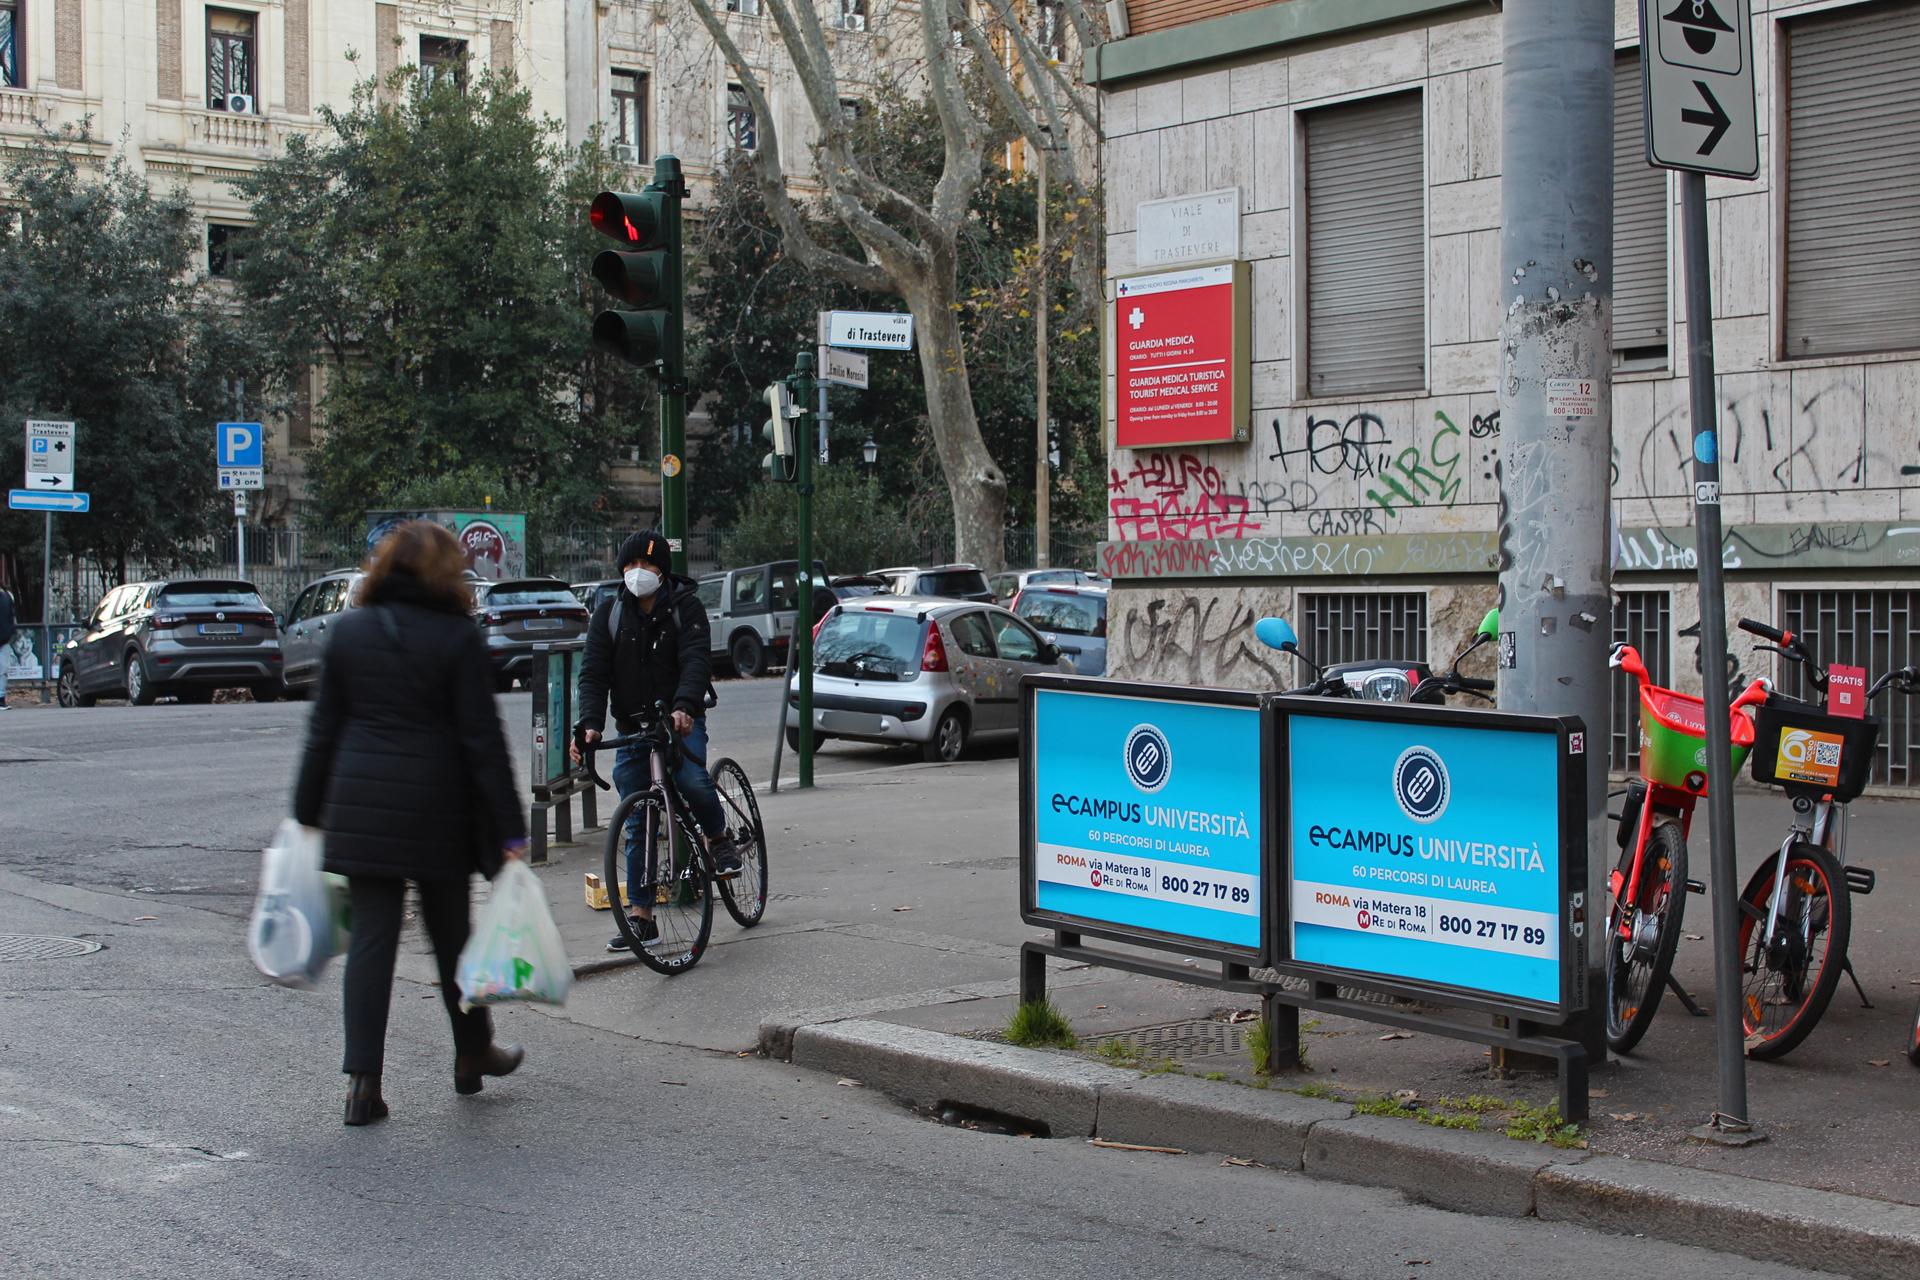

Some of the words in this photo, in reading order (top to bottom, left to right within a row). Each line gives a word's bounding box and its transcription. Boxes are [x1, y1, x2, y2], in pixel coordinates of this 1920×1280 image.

[1171, 204, 1202, 218] VIALE
[1182, 225, 1191, 237] DI
[847, 328, 856, 340] di
[859, 328, 906, 342] Trastevere
[1130, 338, 1164, 350] GUARDIA
[1165, 335, 1194, 346] MEDICA
[1130, 376, 1161, 388] GUARDIA
[1162, 374, 1188, 384] MEDICA
[1189, 370, 1225, 382] TURISTICA
[1129, 388, 1159, 399] TOURIST
[1160, 385, 1189, 397] MEDICAL
[1191, 383, 1218, 394] SERVICE
[1579, 383, 1591, 395] 12
[235, 478, 240, 486] 3
[1829, 674, 1863, 687] GRATIS
[1144, 805, 1251, 840] UNIVERSITÀ
[1088, 830, 1100, 841] 60
[1103, 831, 1153, 849] PERCORSI
[1155, 839, 1166, 851] DI
[1168, 841, 1211, 858] LAUREA
[1418, 836, 1546, 874] UNIVERSITÀ
[1056, 853, 1087, 868] ROMA
[1088, 858, 1103, 871] via
[1105, 862, 1139, 876] Matera
[1140, 866, 1151, 878] 18
[1352, 865, 1367, 878] 60
[1369, 866, 1429, 886] PERCORSI
[1431, 874, 1444, 888] DI
[1447, 875, 1498, 895] LAUREA
[1161, 875, 1189, 894] 800
[1192, 880, 1210, 897] 27
[1213, 883, 1228, 900] 17
[1231, 886, 1250, 904] 89
[1315, 891, 1350, 908] ROMA
[1353, 896, 1369, 910] via
[1372, 899, 1412, 917] Matera
[1414, 905, 1427, 918] 18
[1439, 914, 1472, 935] 800
[1476, 920, 1497, 939] 27
[1500, 923, 1519, 942] 17
[1523, 927, 1546, 946] 89
